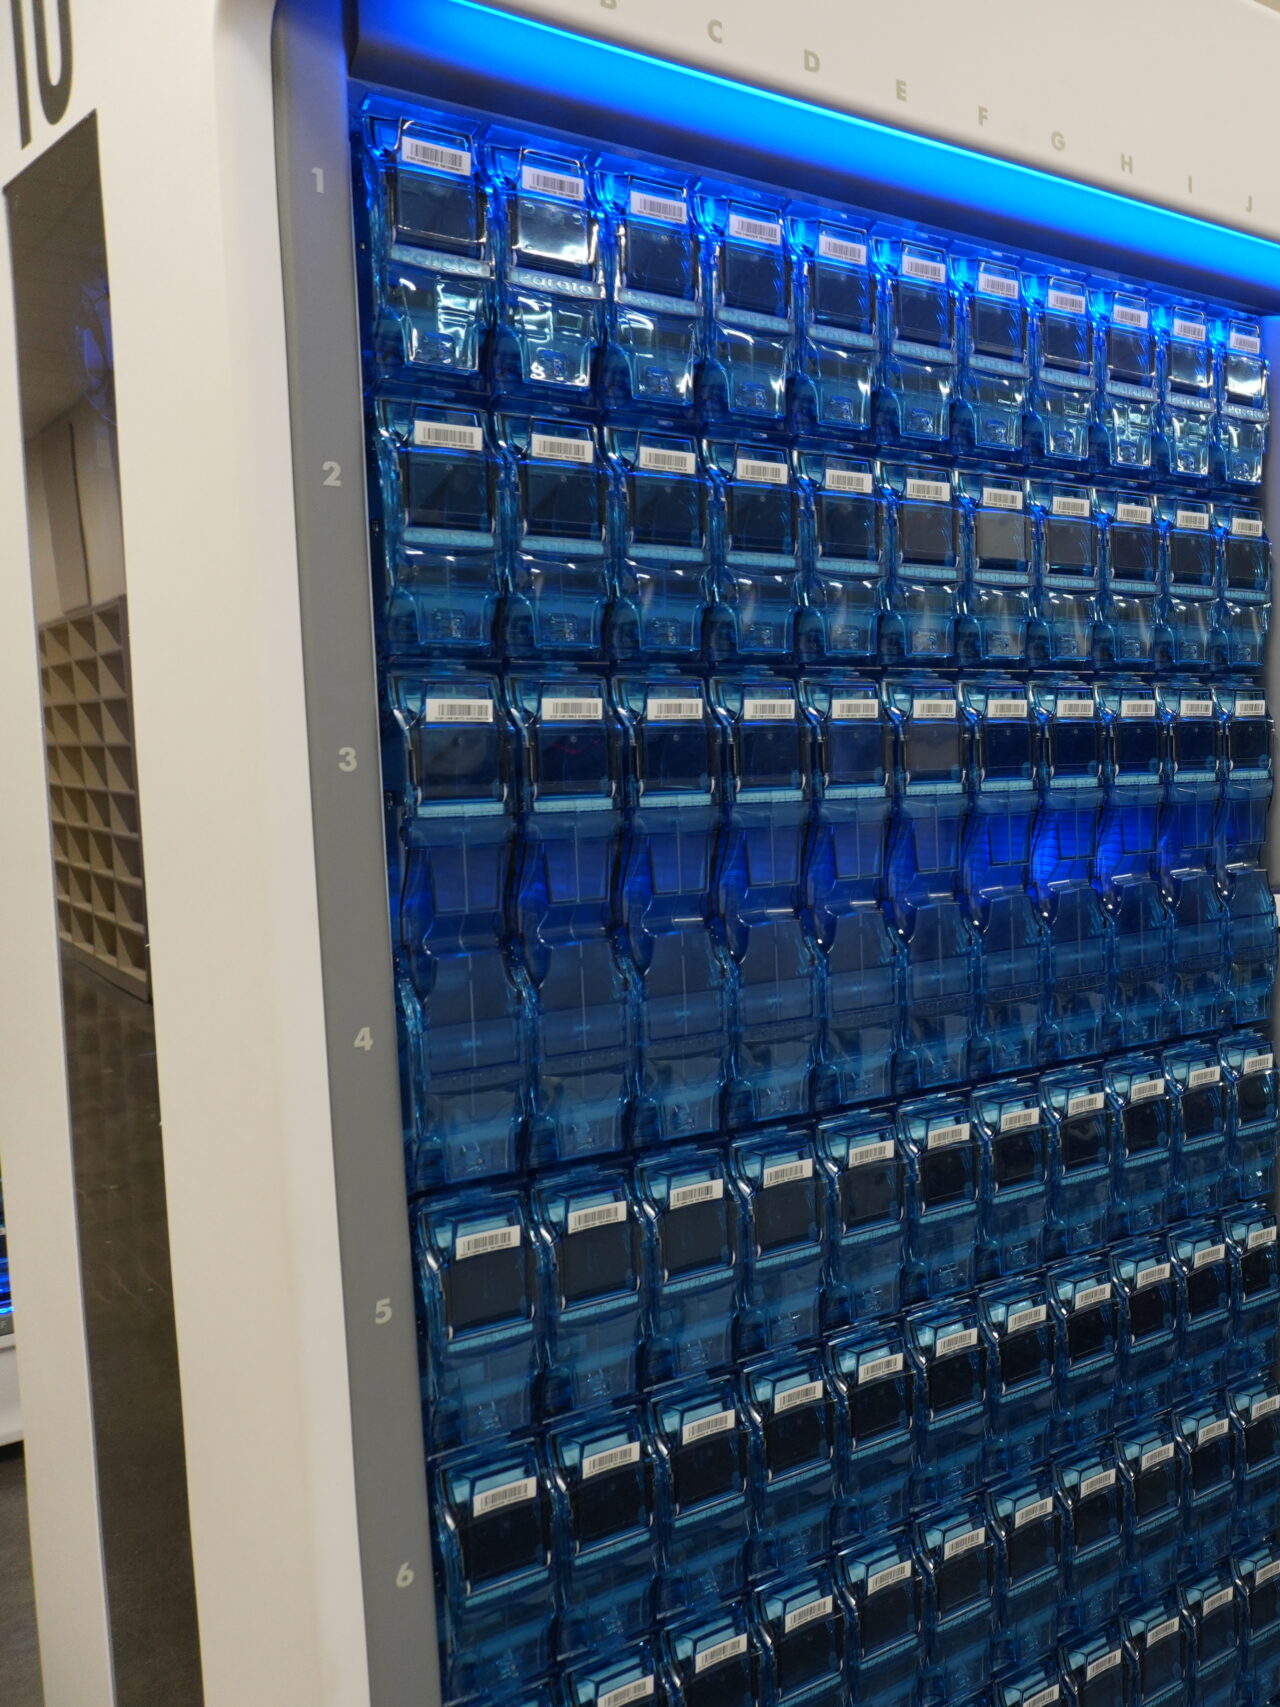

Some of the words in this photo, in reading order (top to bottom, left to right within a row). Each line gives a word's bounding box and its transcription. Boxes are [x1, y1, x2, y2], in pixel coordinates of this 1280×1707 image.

[707, 19, 723, 44] C
[804, 49, 820, 72] D
[896, 79, 908, 101] E
[978, 106, 989, 126] F
[1050, 131, 1065, 151] G
[1121, 153, 1133, 174] H
[1187, 176, 1192, 193] I
[1245, 196, 1252, 214] J
[312, 168, 325, 194] 1
[322, 460, 342, 487] 2
[338, 746, 358, 772] 3
[353, 1026, 374, 1052] 4
[375, 1298, 393, 1324] 5
[395, 1561, 415, 1588] 6
